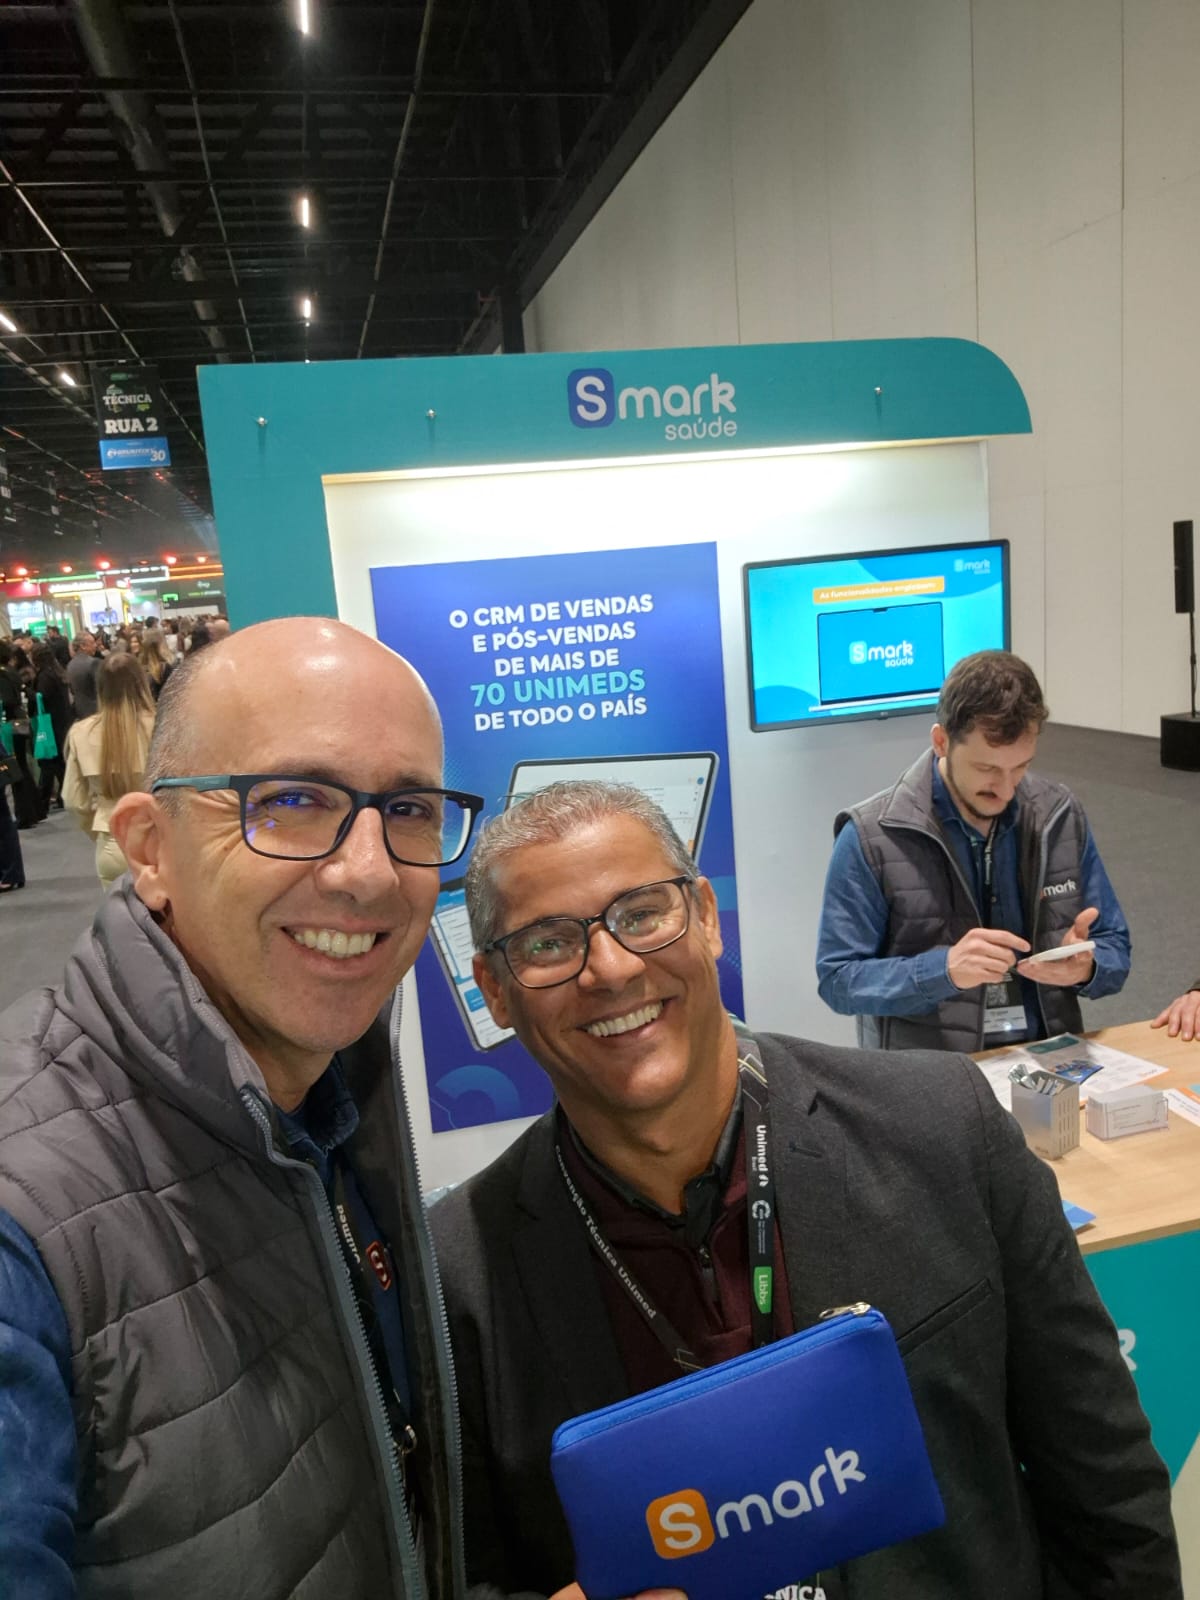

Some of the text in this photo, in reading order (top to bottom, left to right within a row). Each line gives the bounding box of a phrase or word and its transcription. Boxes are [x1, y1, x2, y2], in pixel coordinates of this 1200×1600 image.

[104, 417, 158, 434] RUA 2
[665, 416, 737, 440] saúde
[449, 594, 654, 629] O CRM DE VENDAS
[473, 620, 636, 653] E PÓS-VENDAS
[495, 648, 620, 677] DE MAIS DE
[470, 669, 646, 707] 70 UNIMEDS
[475, 693, 647, 731] DE TODO O PAÍS
[1043, 879, 1076, 897] mark
[756, 1125, 768, 1173] Unimed
[586, 1213, 617, 1267] Técnica
[618, 1267, 656, 1319] Unimed
[758, 1274, 768, 1305] Libbs
[660, 1447, 866, 1549] Smark
[764, 1585, 827, 1600] NICA
